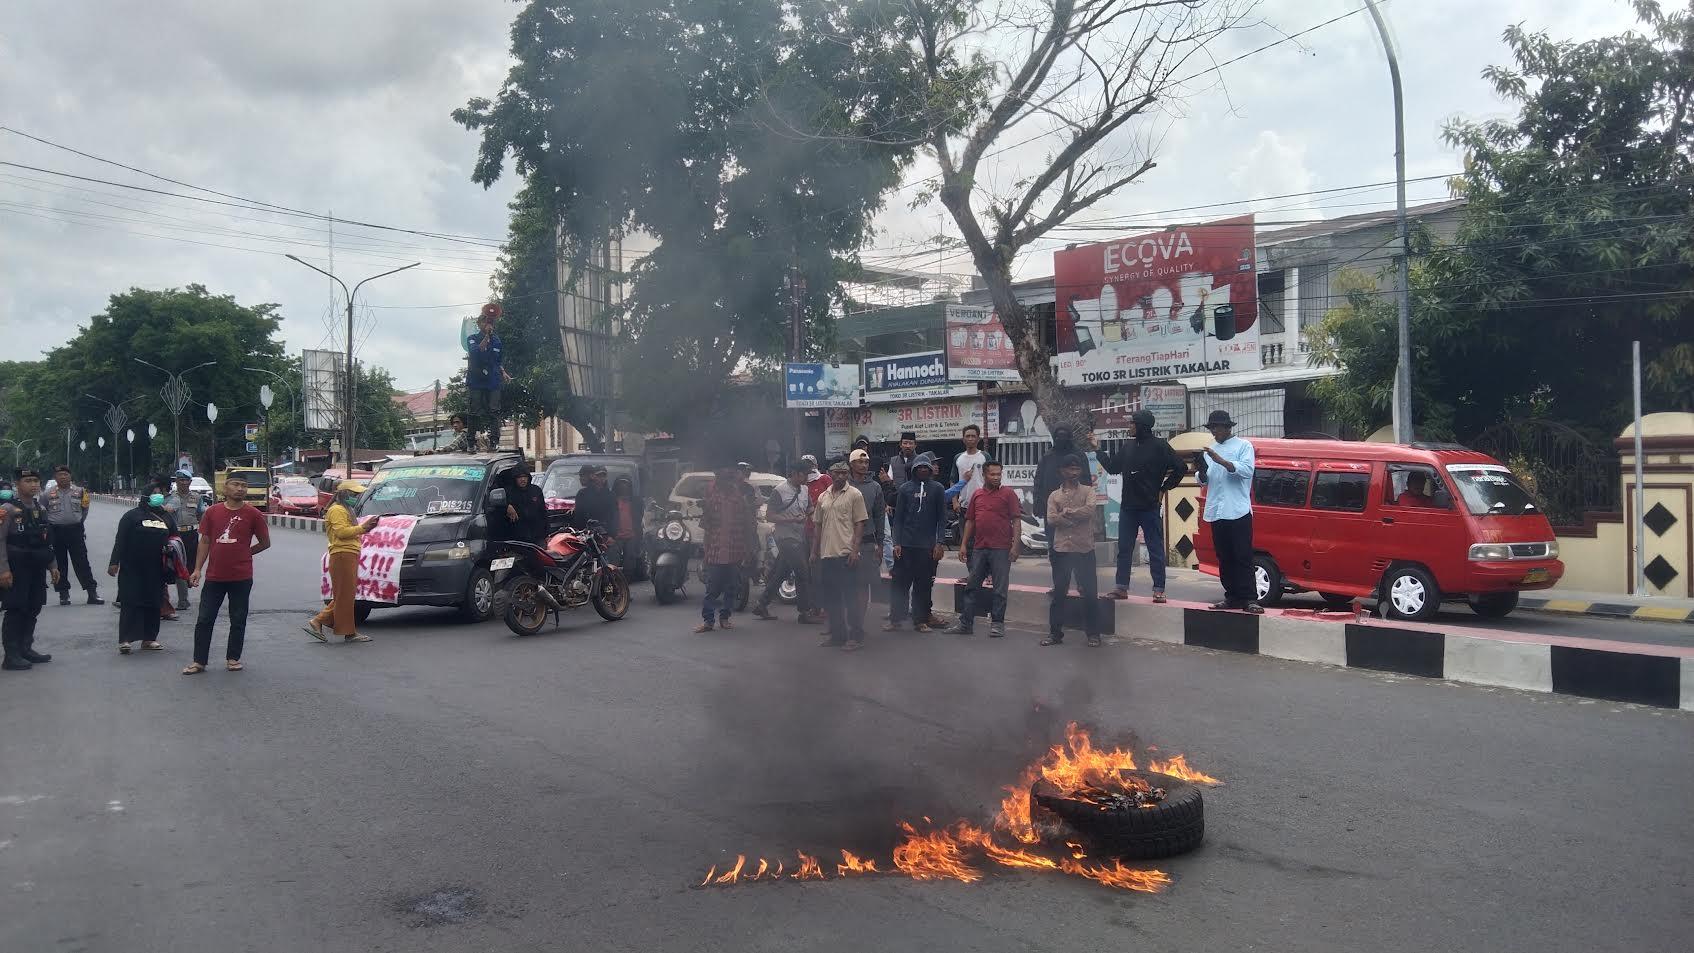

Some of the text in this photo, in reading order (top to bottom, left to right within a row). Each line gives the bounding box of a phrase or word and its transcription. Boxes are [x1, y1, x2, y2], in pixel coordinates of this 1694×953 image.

[1104, 232, 1193, 274] ECOVA
[1104, 263, 1194, 283] SYNERGY OF QUALITY
[1116, 350, 1190, 365] #TerangTiapHari
[887, 357, 944, 381] Hannoch
[1082, 360, 1231, 383] TOKO 3R LISTRIK TAKALAR
[898, 407, 913, 422] 3R
[916, 404, 963, 420] LISTRIK
